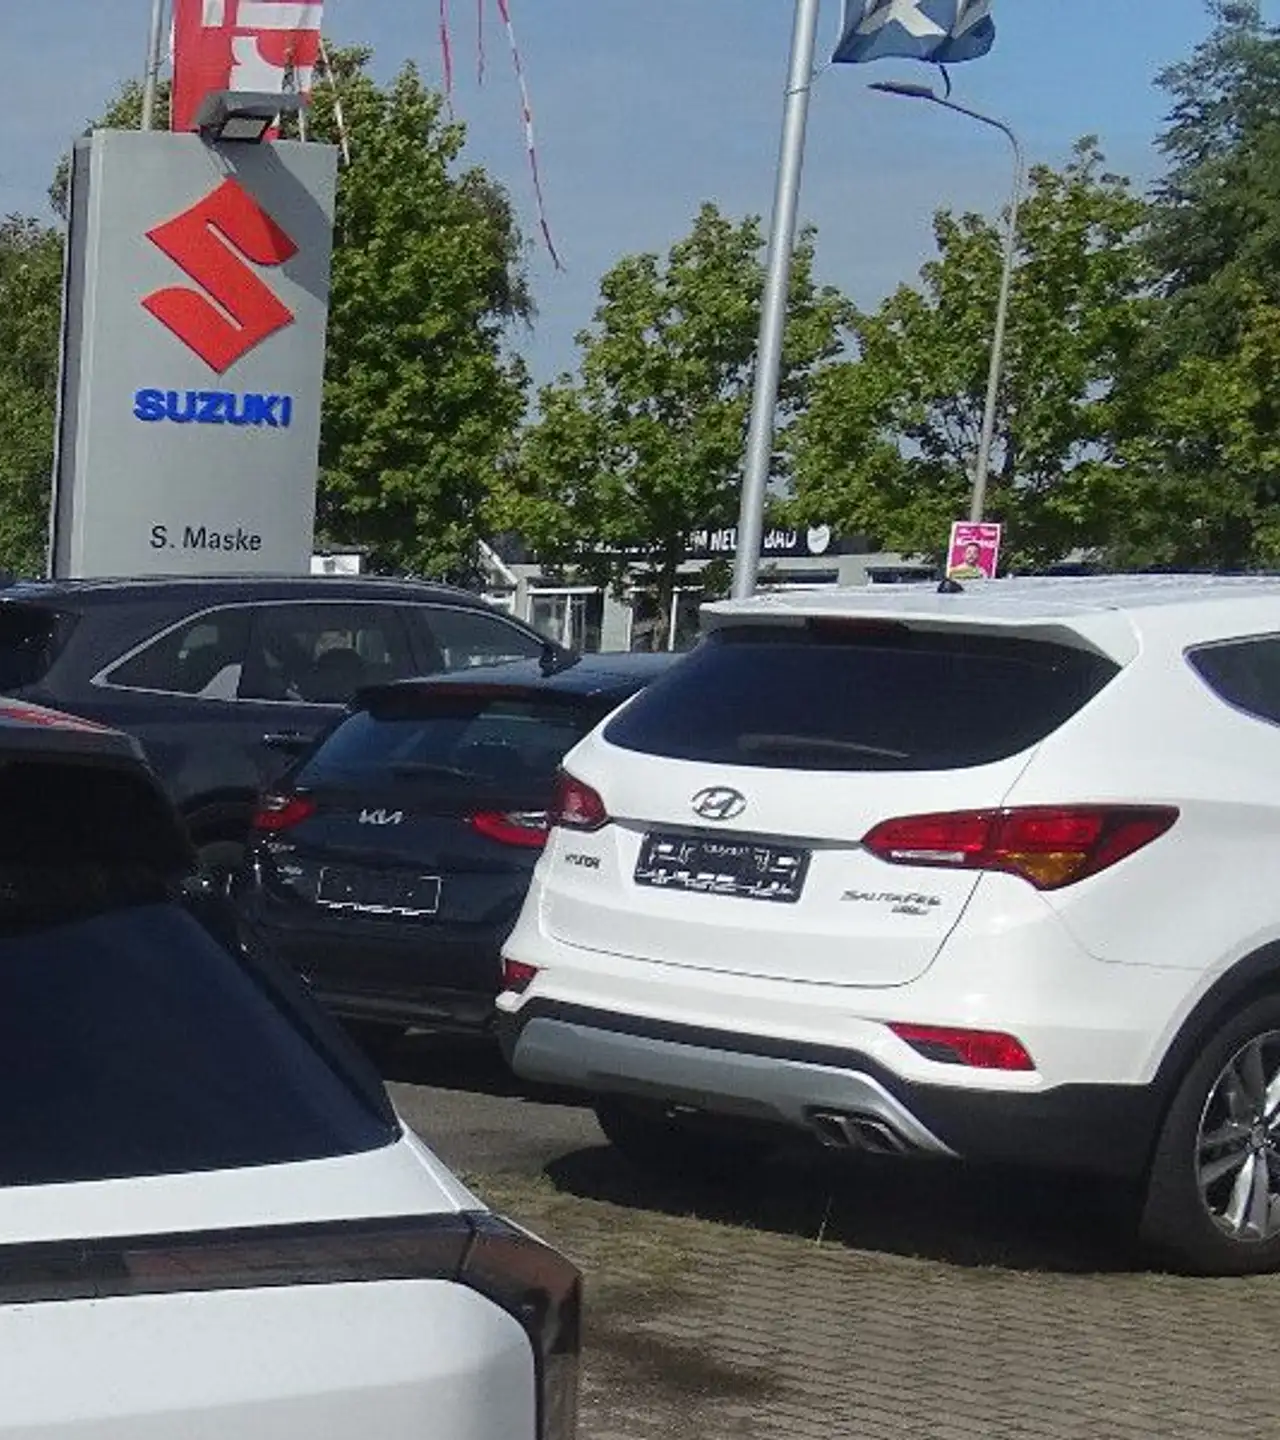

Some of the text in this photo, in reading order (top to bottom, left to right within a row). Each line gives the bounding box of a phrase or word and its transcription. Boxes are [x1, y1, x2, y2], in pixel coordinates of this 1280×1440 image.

[133, 388, 292, 428] SUZUKI
[149, 526, 263, 552] S. Maske
